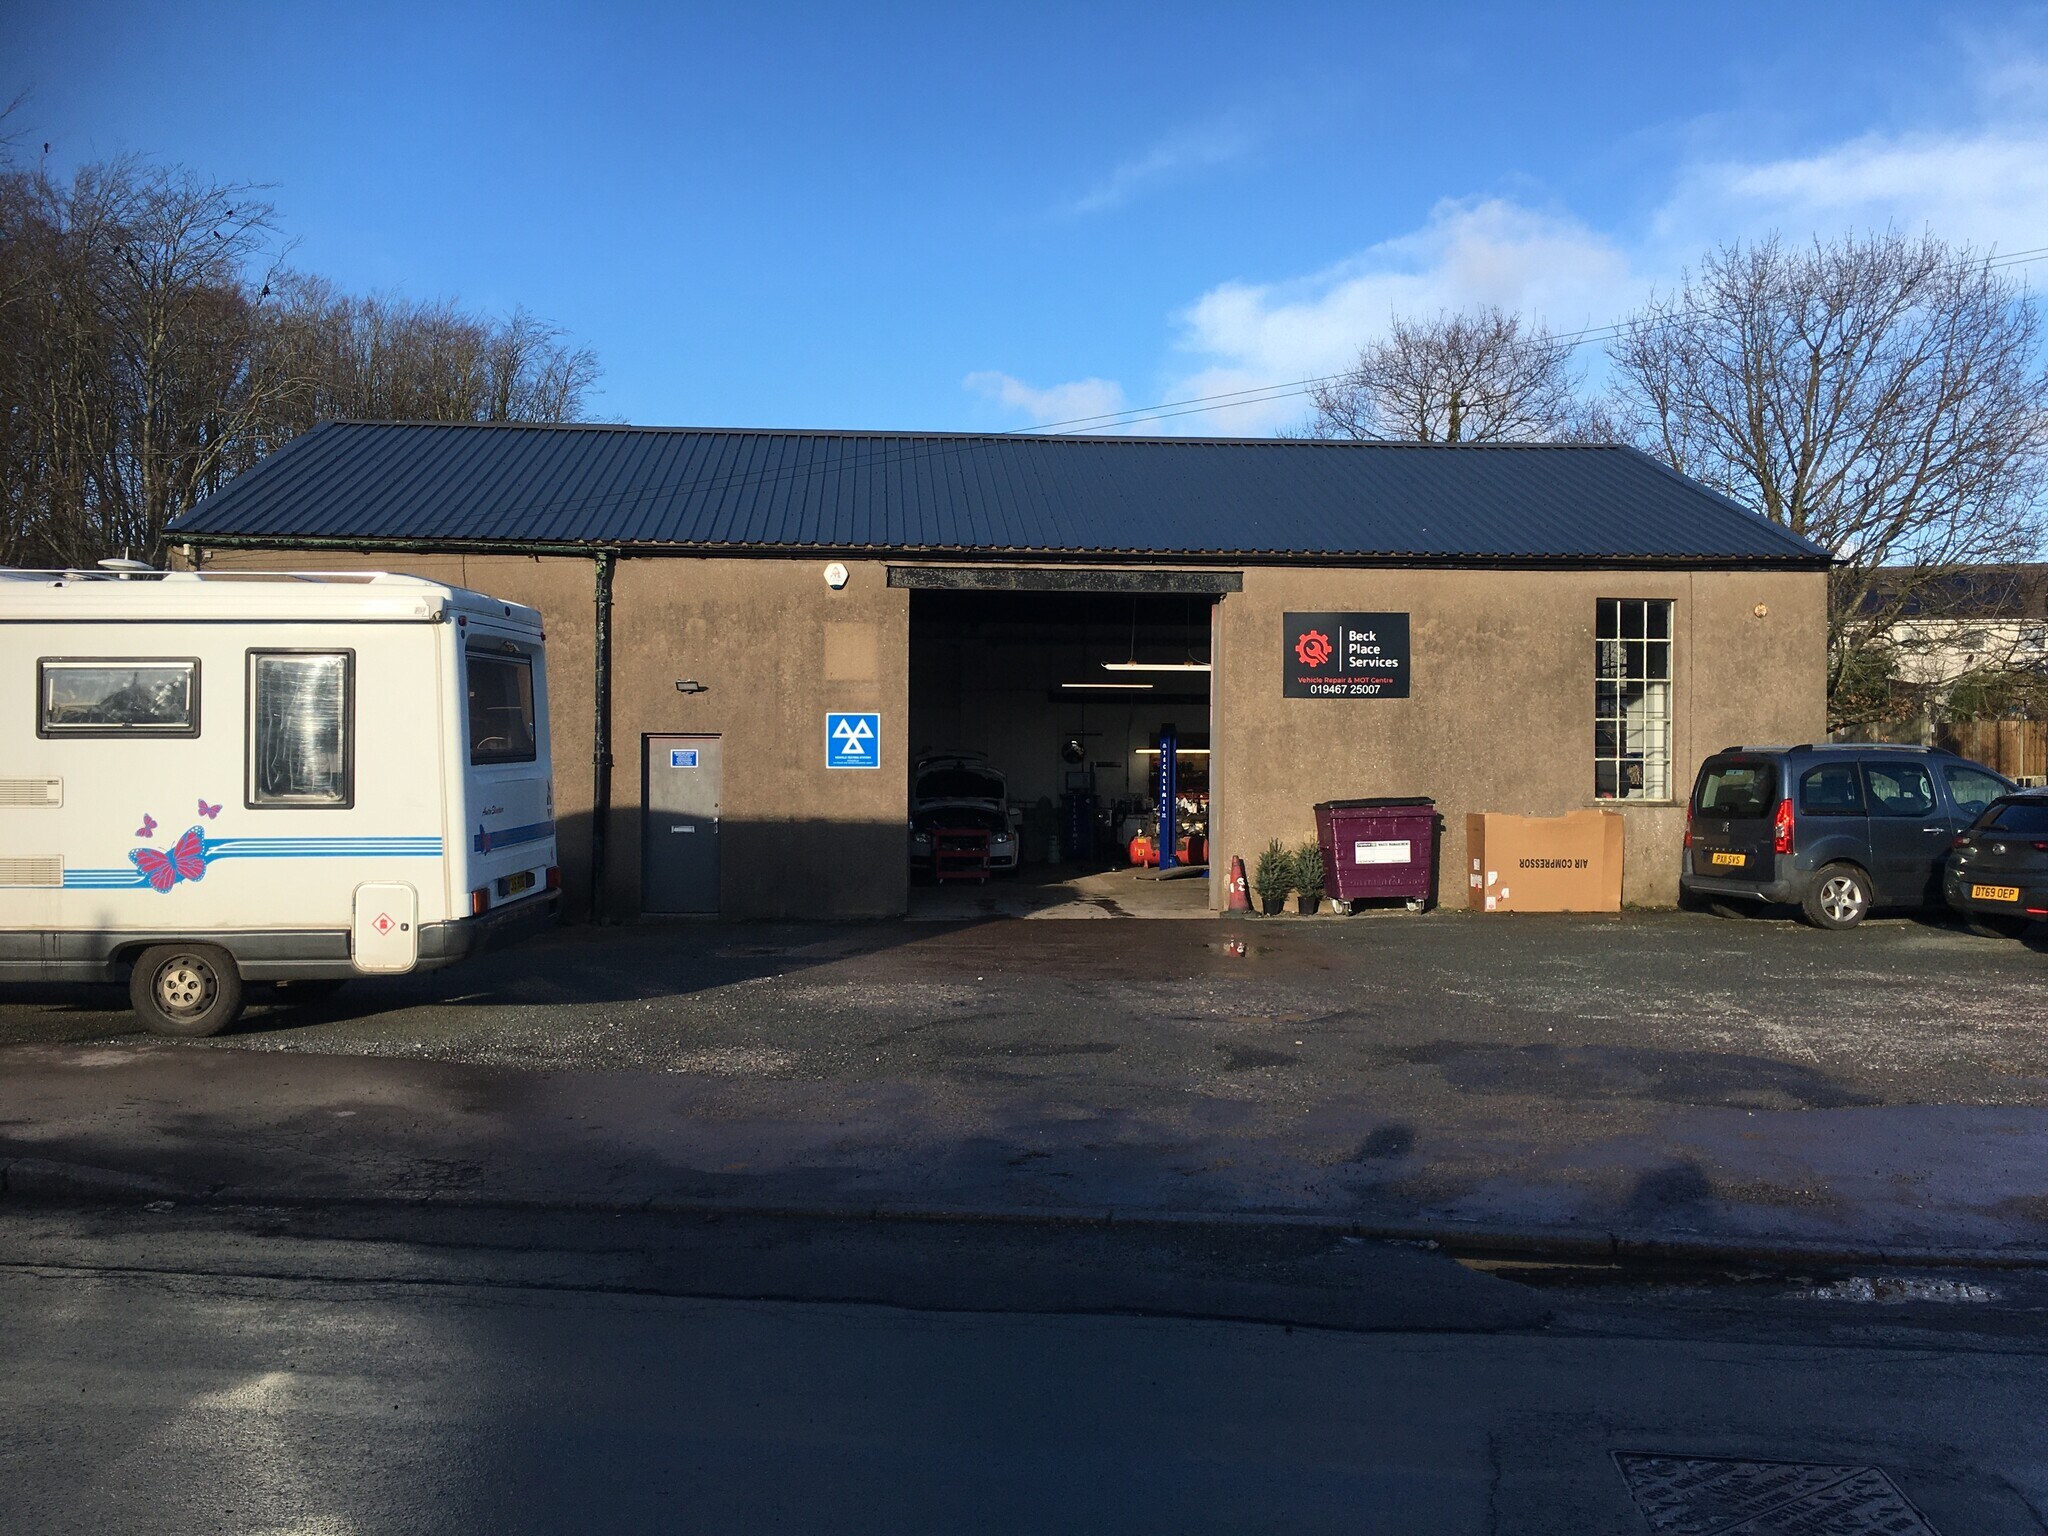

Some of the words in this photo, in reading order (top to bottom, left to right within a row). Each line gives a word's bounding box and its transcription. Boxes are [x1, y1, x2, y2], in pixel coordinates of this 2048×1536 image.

[1348, 630, 1377, 641] Beck
[1348, 643, 1381, 654] Place
[1348, 656, 1399, 667] Services
[1310, 684, 1348, 694] 019467
[1349, 684, 1381, 694] 25007
[1519, 858, 1573, 868] COMPRESSOR
[1574, 858, 1589, 868] AIR
[1975, 887, 1996, 897] DT69
